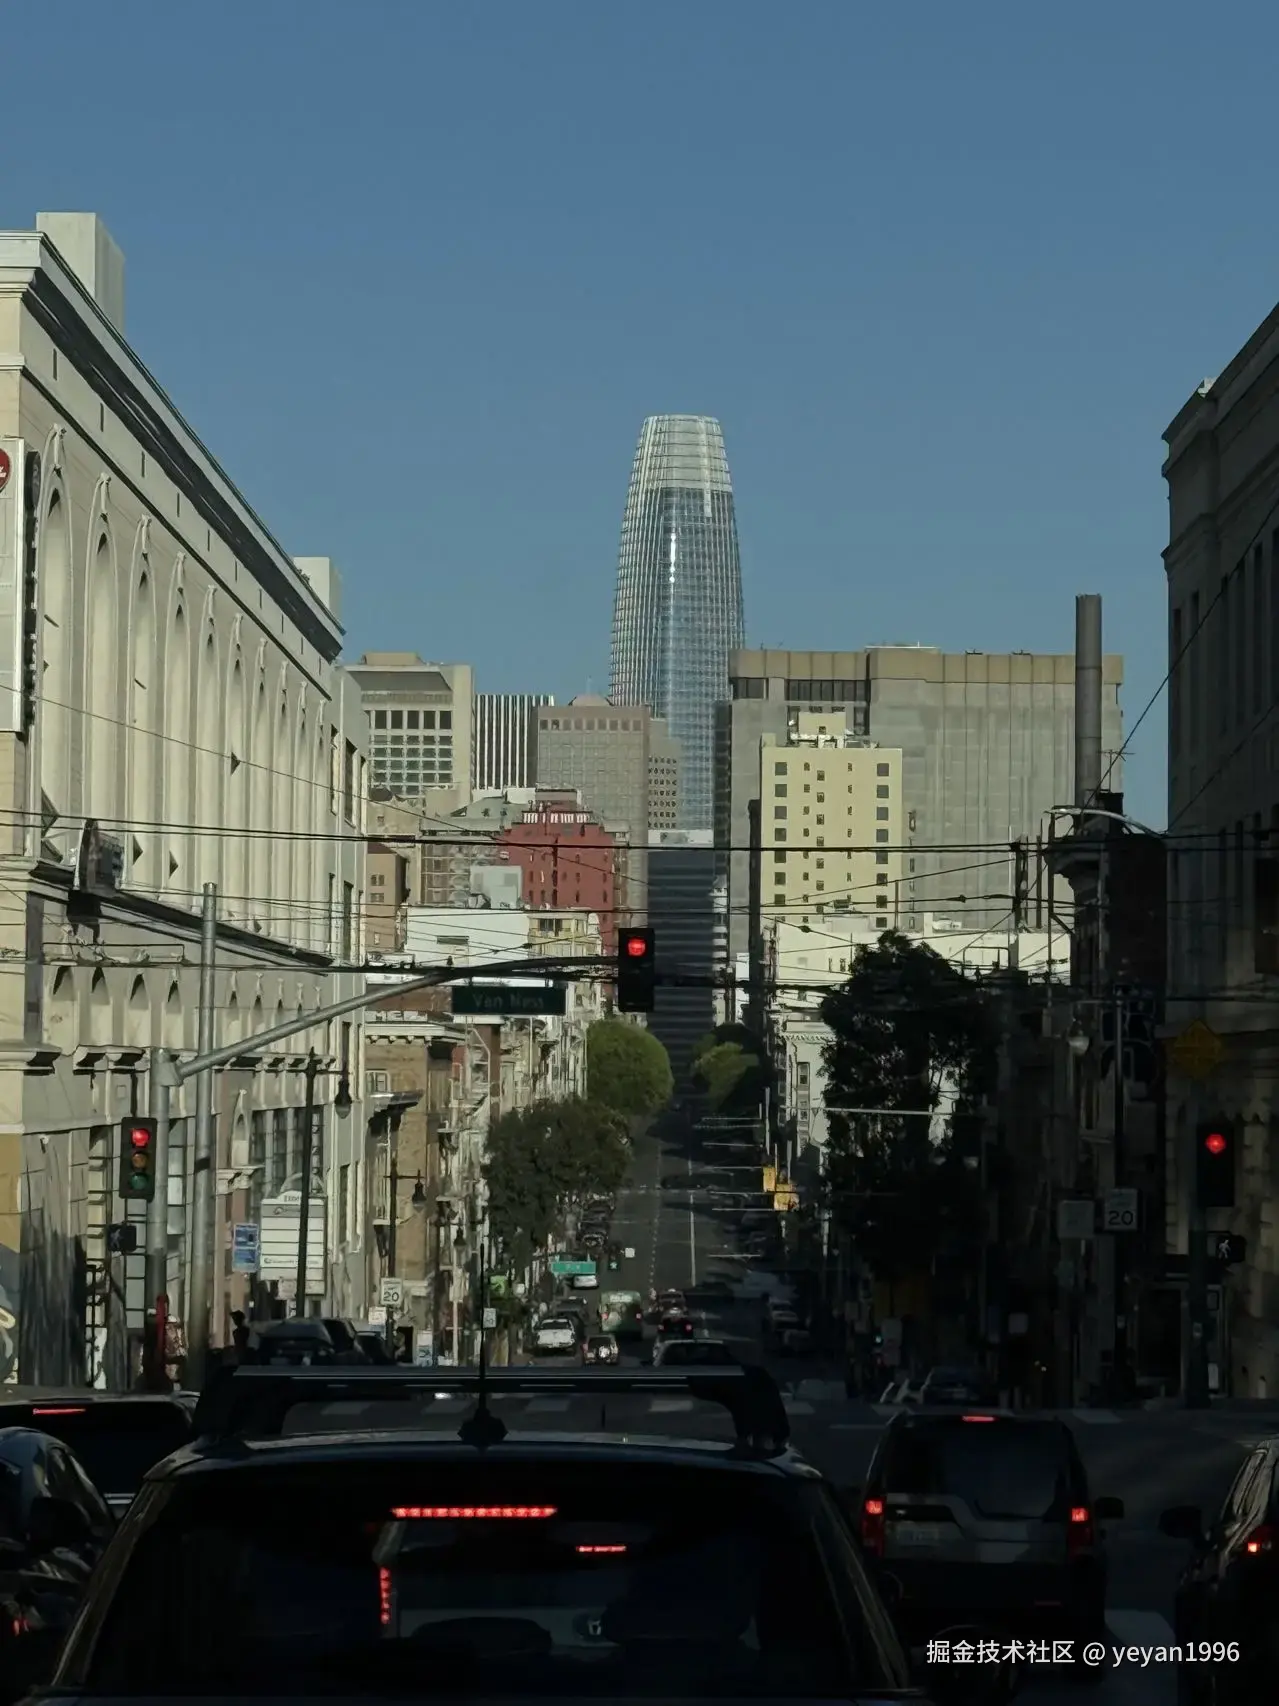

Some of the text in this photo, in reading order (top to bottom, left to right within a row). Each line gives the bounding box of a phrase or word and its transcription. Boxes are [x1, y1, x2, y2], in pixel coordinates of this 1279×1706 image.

[473, 993, 503, 1009] Van
[1108, 1210, 1133, 1225] 20
[383, 1291, 400, 1303] 20
